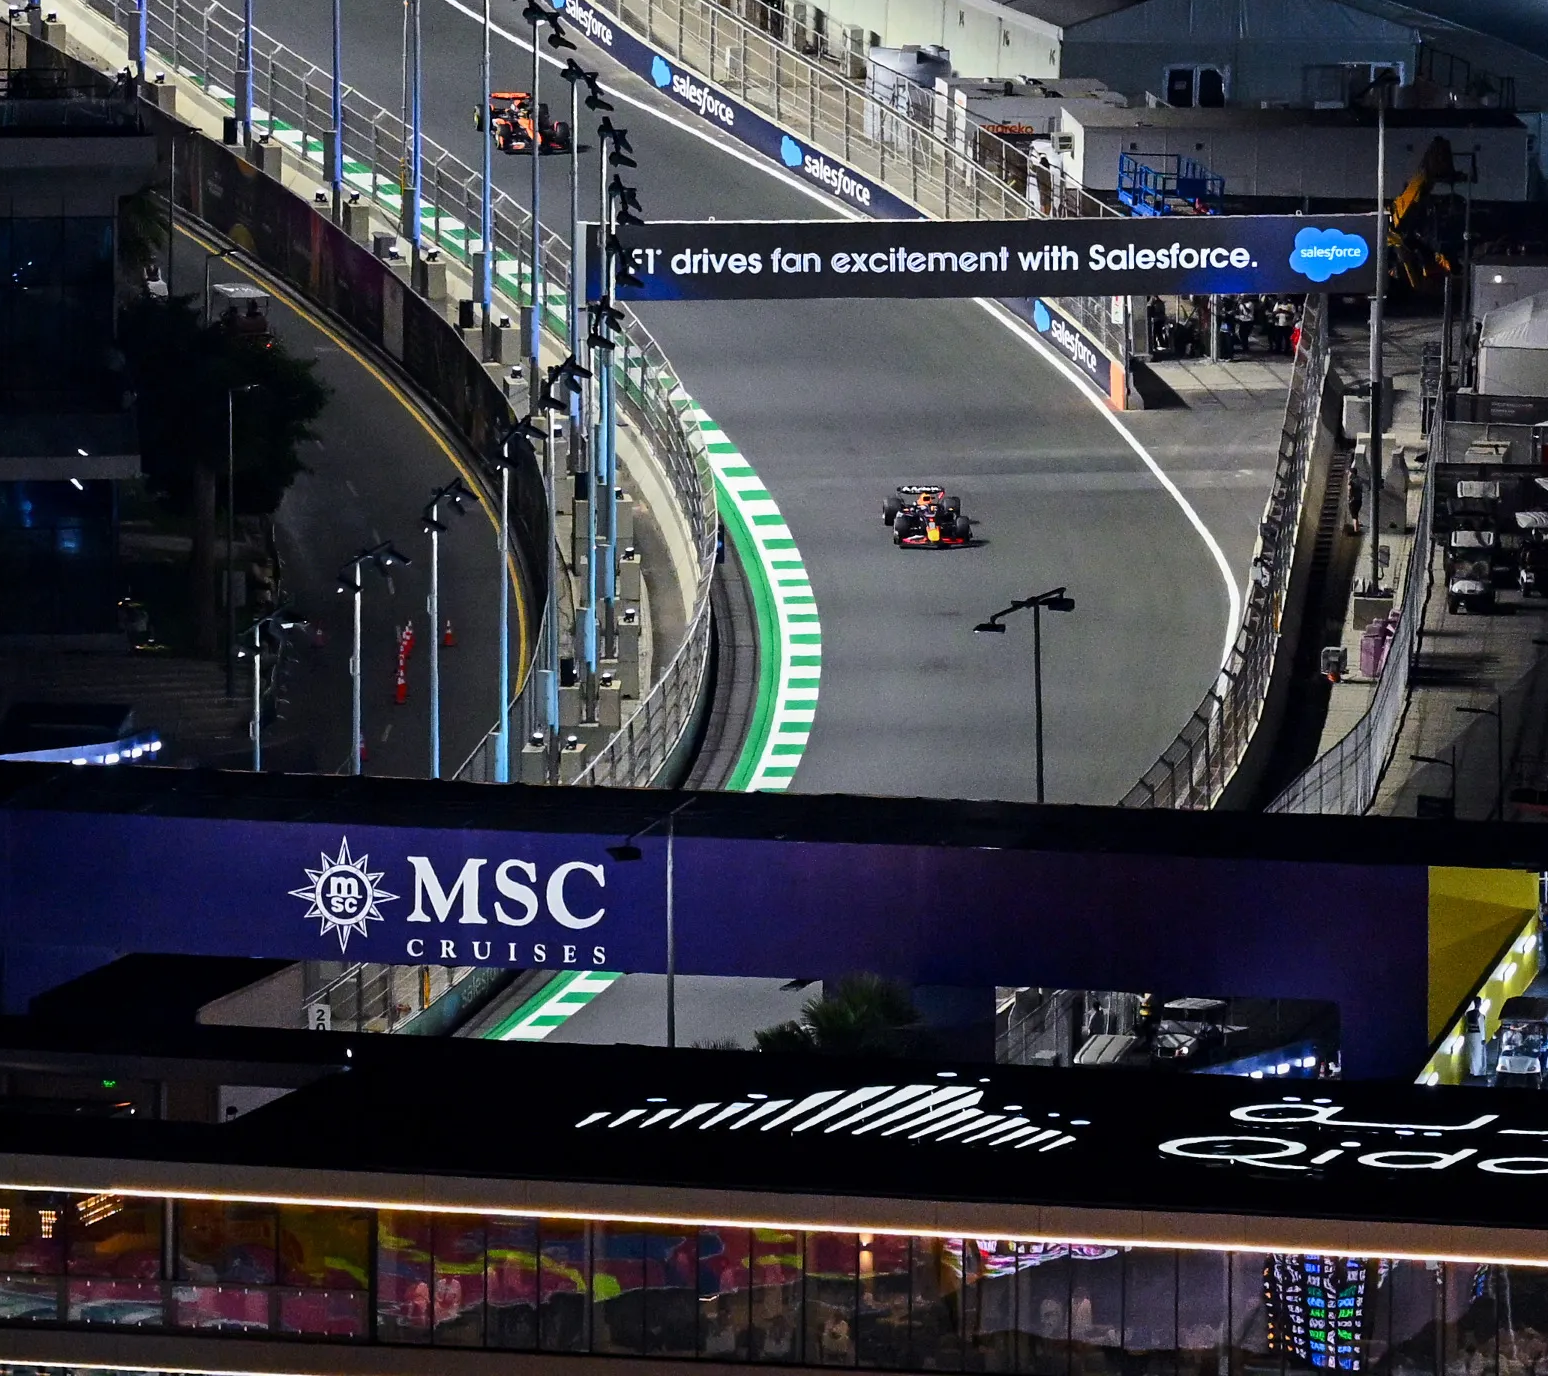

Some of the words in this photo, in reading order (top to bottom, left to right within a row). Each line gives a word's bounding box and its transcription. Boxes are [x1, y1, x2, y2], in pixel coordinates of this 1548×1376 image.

[672, 72, 734, 127] salesforce
[804, 152, 871, 206] salesforce
[670, 247, 763, 277] drives
[770, 247, 823, 275] fan
[830, 246, 1008, 275] excitement
[1018, 244, 1081, 273] with
[1088, 242, 1258, 272] Salesforce.
[1300, 244, 1362, 262] salesforce
[1051, 317, 1098, 374] salesforce
[407, 856, 605, 929] MSC
[407, 939, 606, 964] CRUISES
